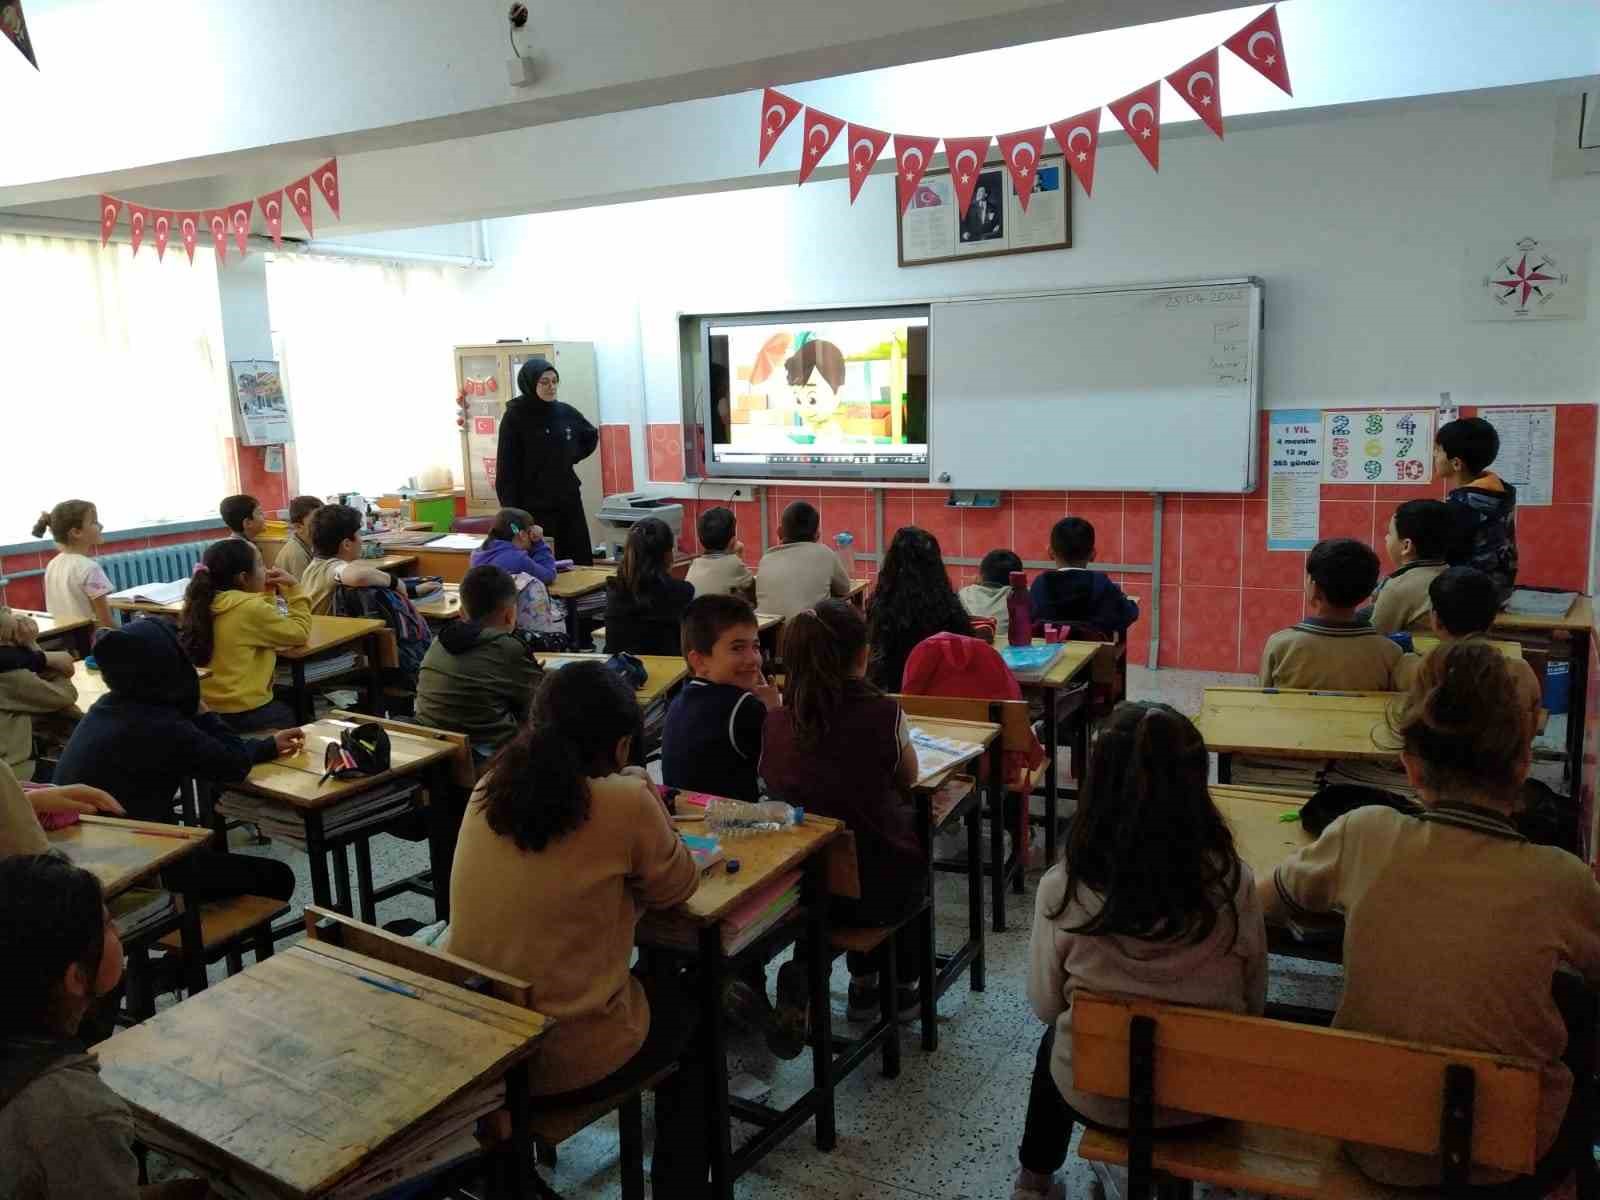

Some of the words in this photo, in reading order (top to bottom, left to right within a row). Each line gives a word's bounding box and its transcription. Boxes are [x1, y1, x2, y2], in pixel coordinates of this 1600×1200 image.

[1294, 425, 1310, 434] YIL
[1332, 415, 1350, 435] 2
[1365, 414, 1383, 434] 3
[1397, 413, 1416, 435] 4
[1332, 438, 1349, 457] 5
[1396, 437, 1414, 457] 7
[1331, 459, 1349, 479] 8
[1364, 460, 1382, 480] 9
[1395, 460, 1424, 480] 10
